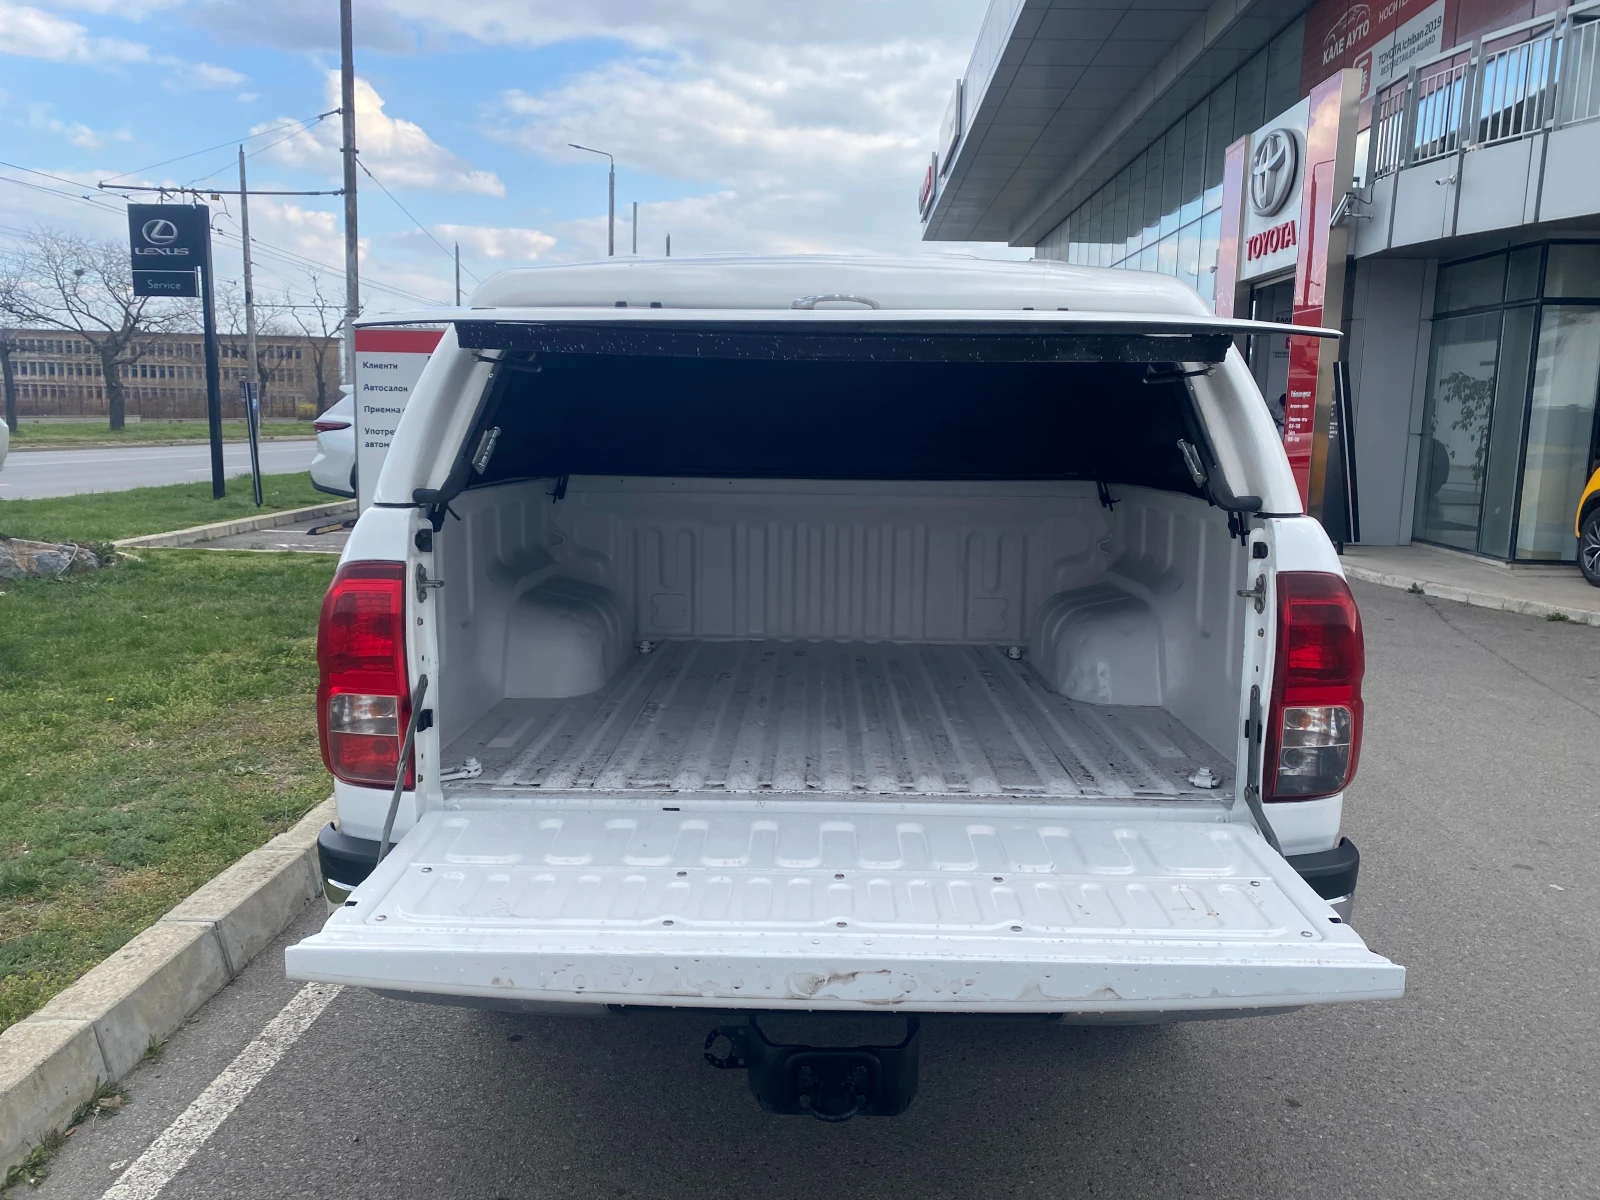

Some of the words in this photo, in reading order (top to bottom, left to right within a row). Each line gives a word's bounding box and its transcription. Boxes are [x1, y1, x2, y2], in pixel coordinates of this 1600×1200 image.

[1378, 0, 1411, 24] НОСИТЕ
[1322, 37, 1345, 66] КАЛЕ
[1345, 19, 1370, 50] АУТО
[1378, 42, 1402, 67] TOYOTA
[1401, 30, 1424, 51] Ichiban
[1424, 15, 1442, 37] 2019
[1380, 61, 1393, 77] BEST
[1393, 47, 1416, 67] RETAILER
[1416, 34, 1436, 53] AWARD
[1246, 220, 1297, 261] TOYOTA
[134, 247, 190, 256] LEXUS
[147, 279, 181, 290] Service
[362, 361, 398, 370] Клиенти
[363, 383, 408, 392] Автосалон
[363, 405, 401, 415] Приемна
[364, 427, 396, 437] Употре
